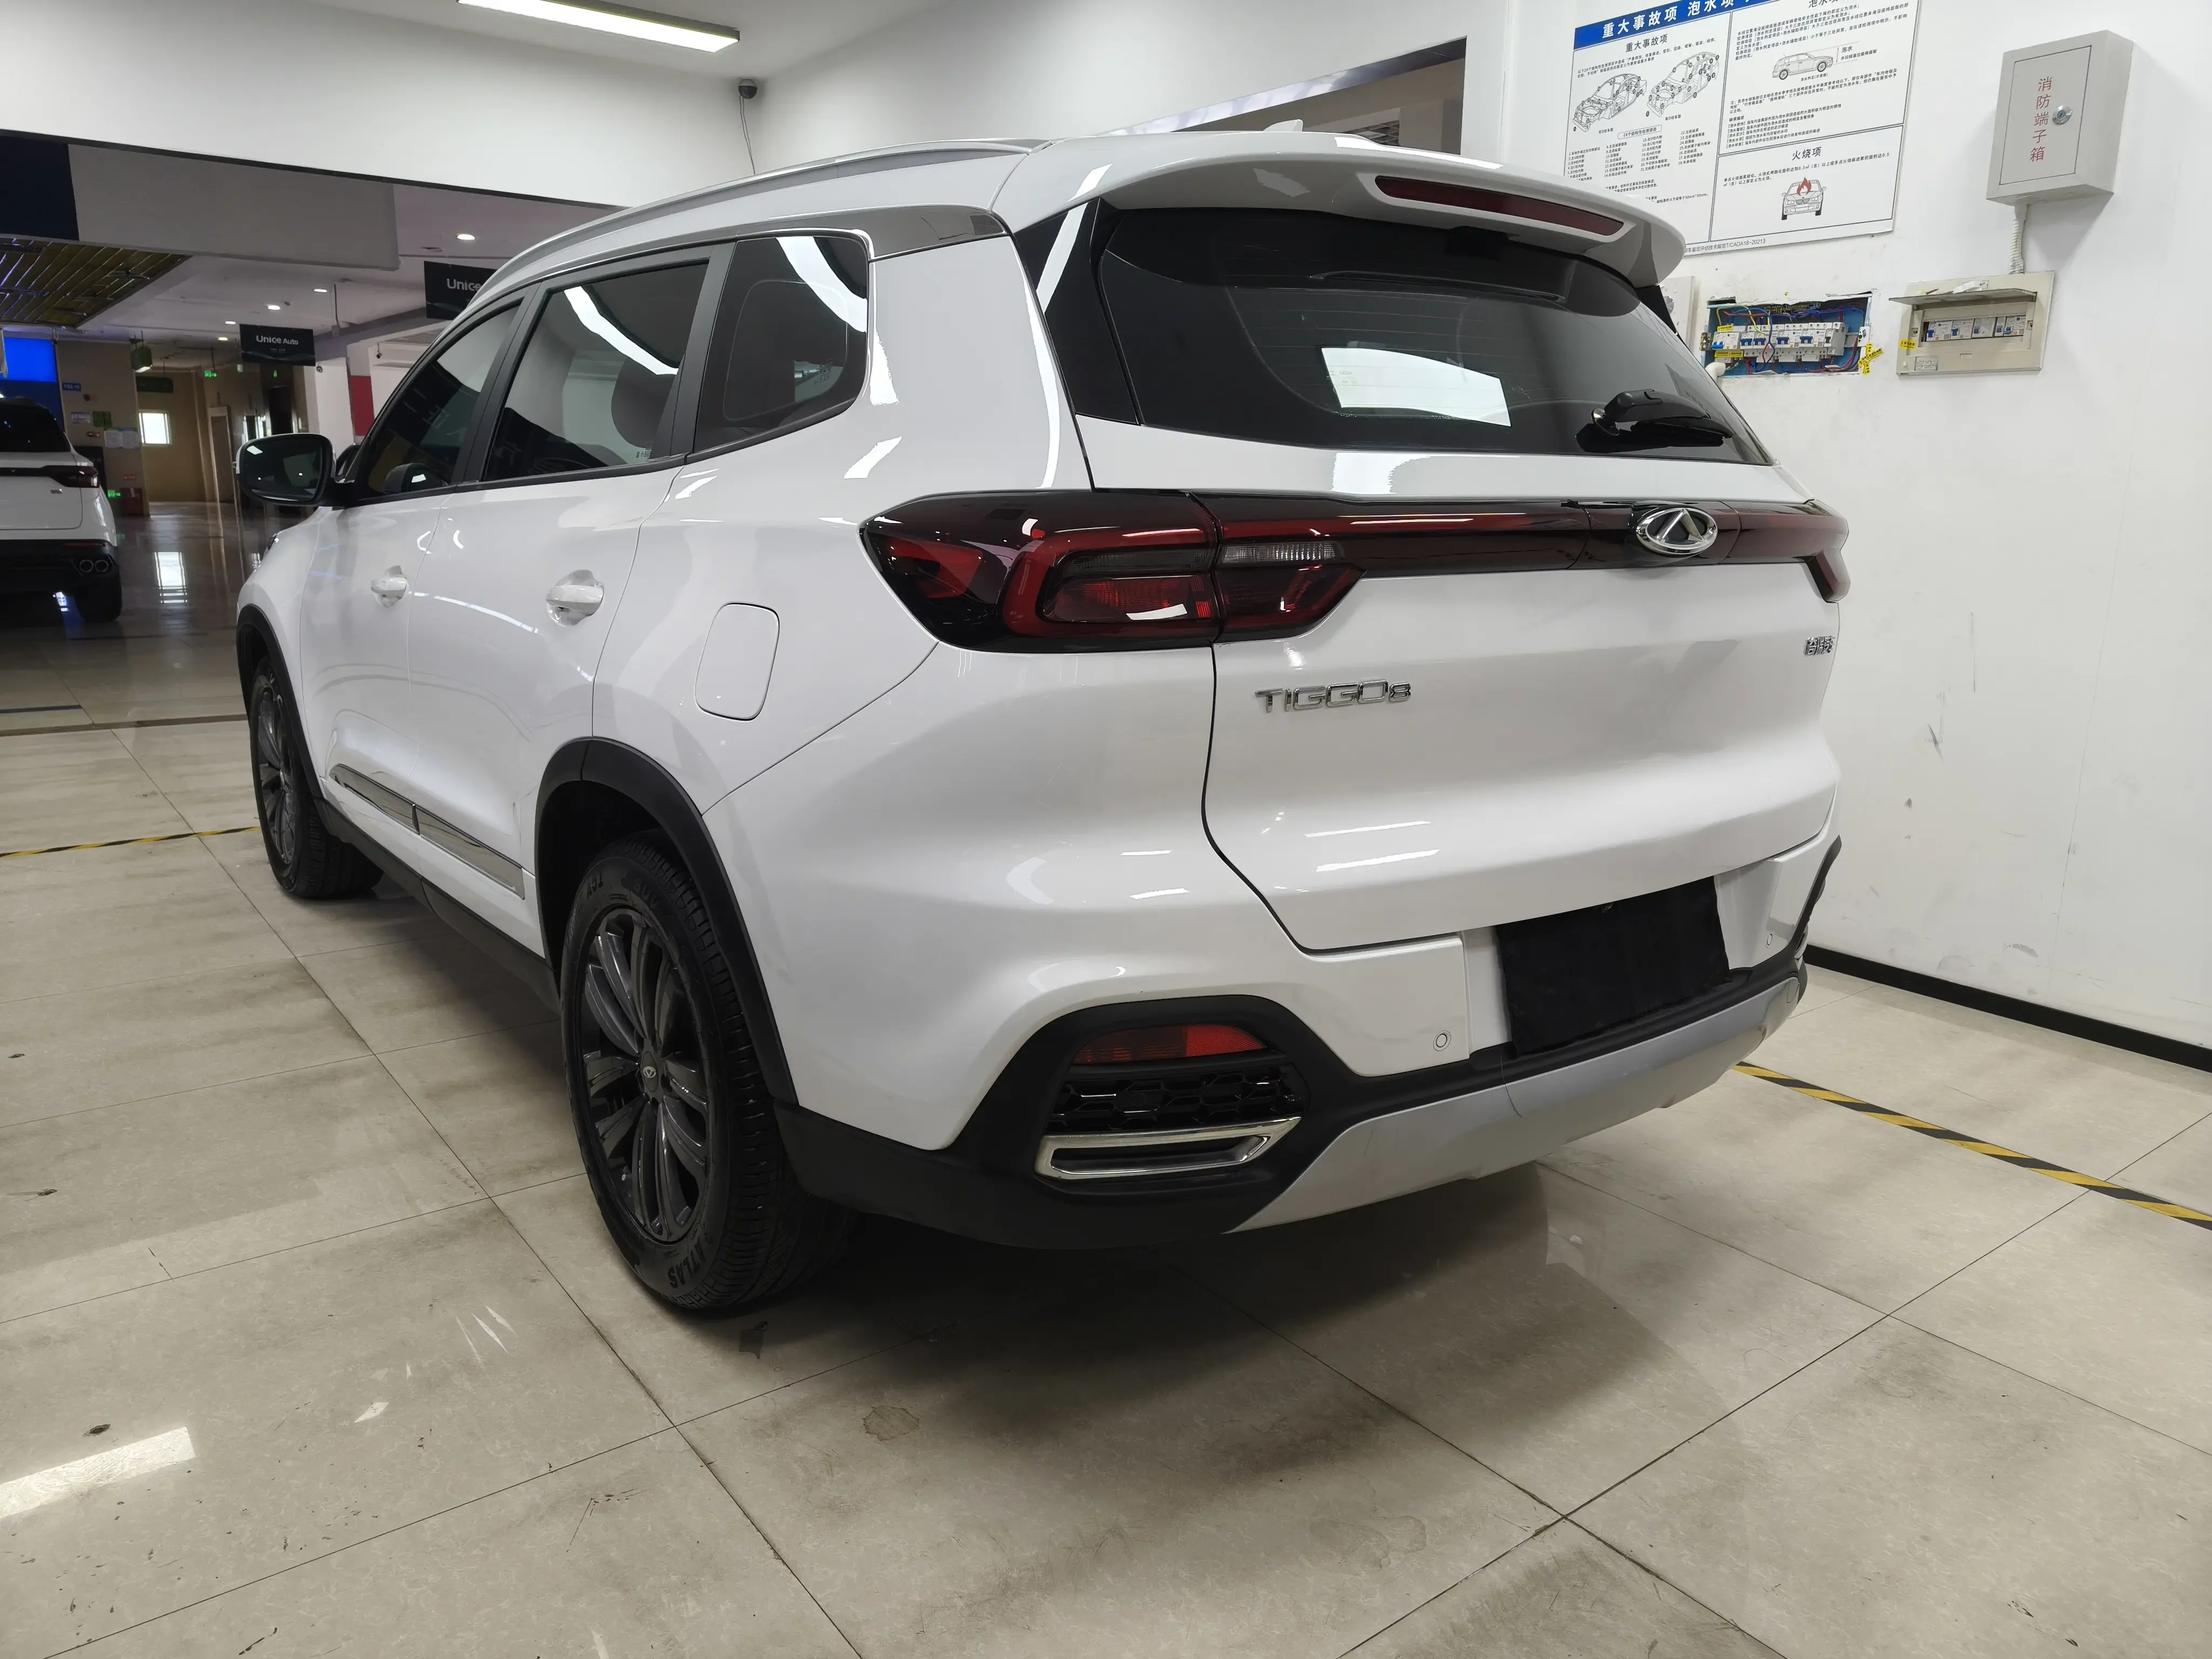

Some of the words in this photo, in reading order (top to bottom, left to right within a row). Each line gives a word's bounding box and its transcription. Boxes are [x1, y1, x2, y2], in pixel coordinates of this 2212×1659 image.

[1809, 0, 1837, 8] 泡水
[1602, 5, 1678, 39] 重大事故项
[1626, 33, 1668, 52] 重大事故项
[2030, 76, 2052, 162] 消防端子箱
[1792, 146, 1821, 160] 火烧项
[447, 278, 481, 292] Unice
[256, 335, 281, 344] Unice
